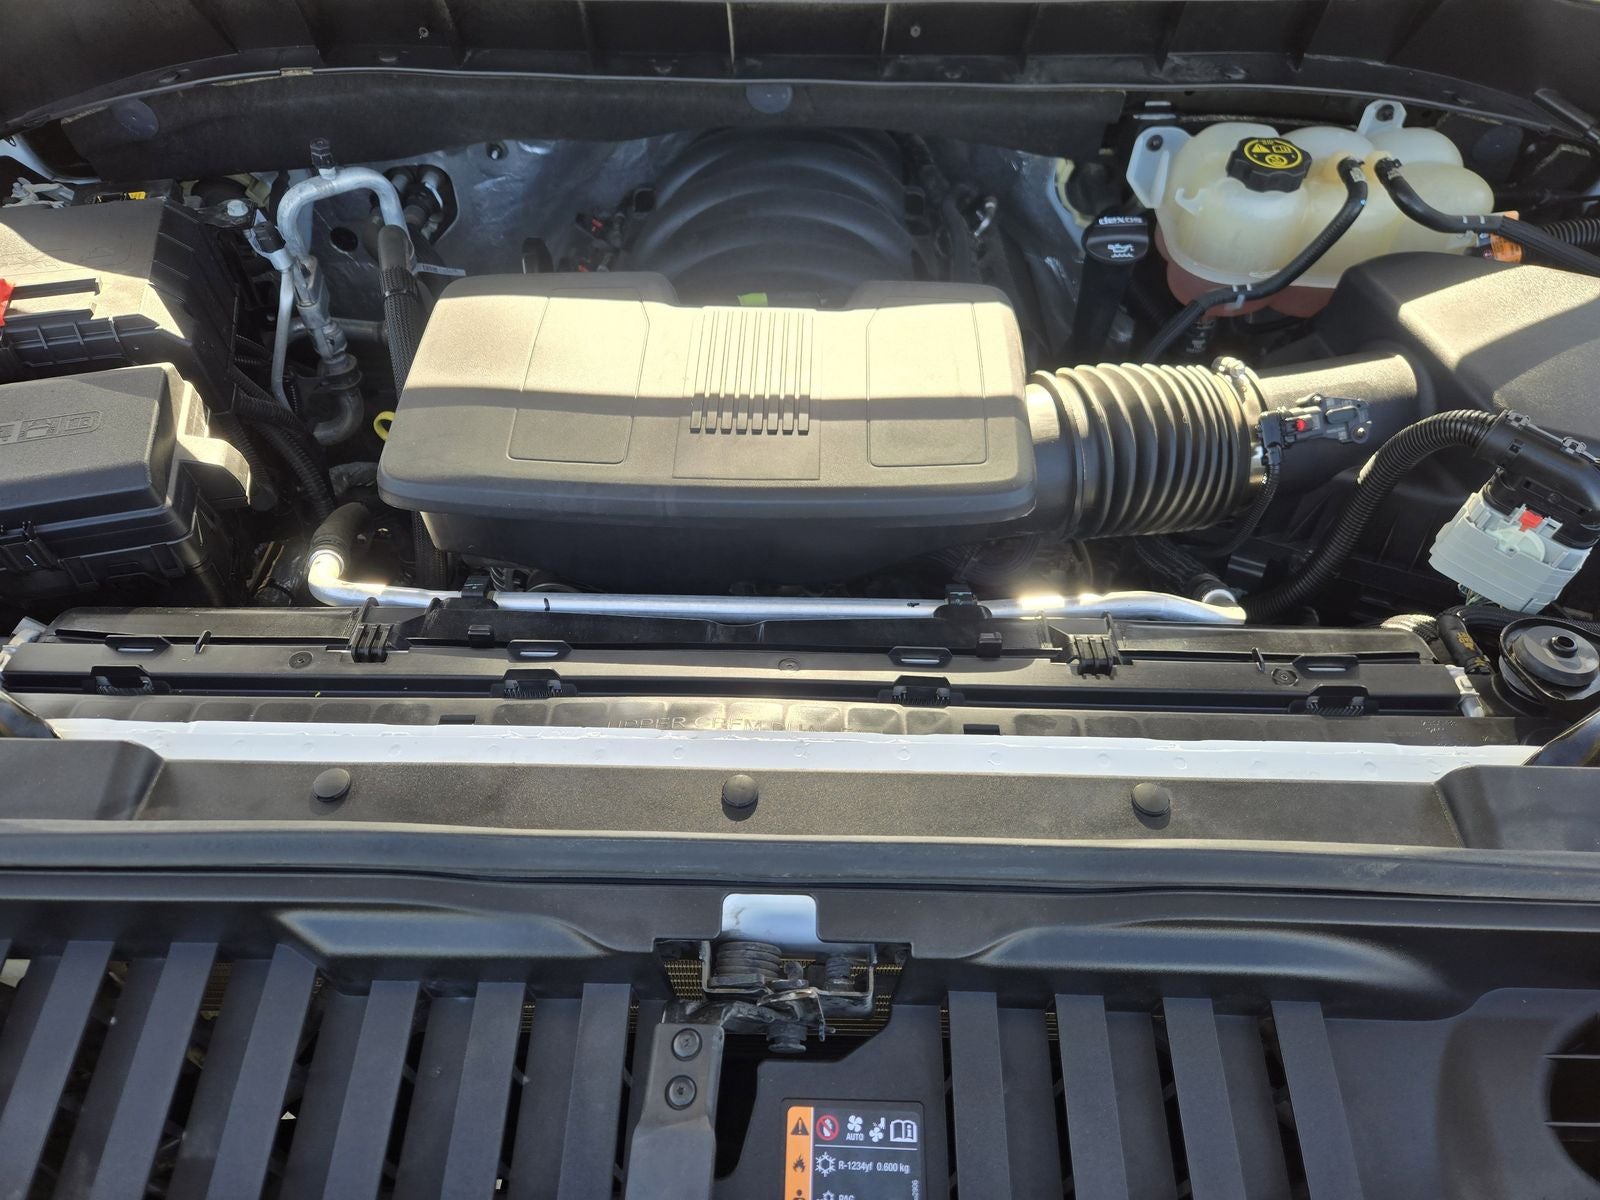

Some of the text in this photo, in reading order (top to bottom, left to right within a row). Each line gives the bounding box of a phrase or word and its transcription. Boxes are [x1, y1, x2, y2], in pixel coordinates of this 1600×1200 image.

[846, 1132, 864, 1141] AUTO
[838, 1160, 910, 1175] R-1234yf 0.600 kg
